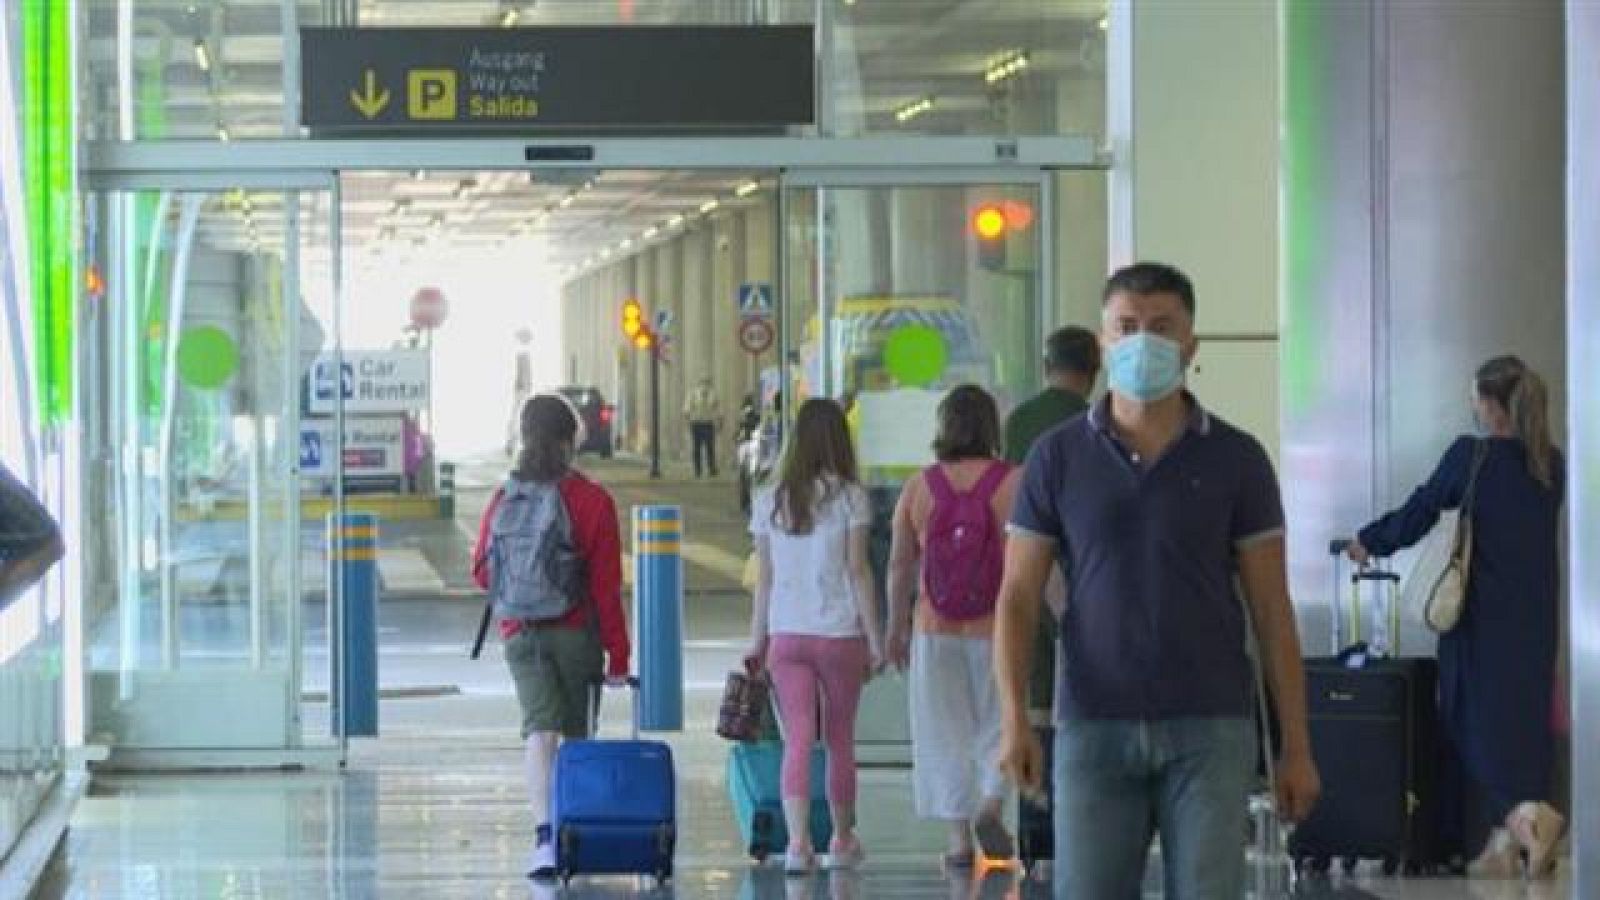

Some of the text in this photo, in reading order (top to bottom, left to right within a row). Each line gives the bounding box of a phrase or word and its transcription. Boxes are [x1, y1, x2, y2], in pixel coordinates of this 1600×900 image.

[470, 47, 545, 71] Ausgang
[470, 73, 538, 94] Way out
[420, 80, 447, 112] P
[469, 95, 539, 116] Salida
[359, 358, 396, 376] Car
[359, 381, 427, 400] Rental
